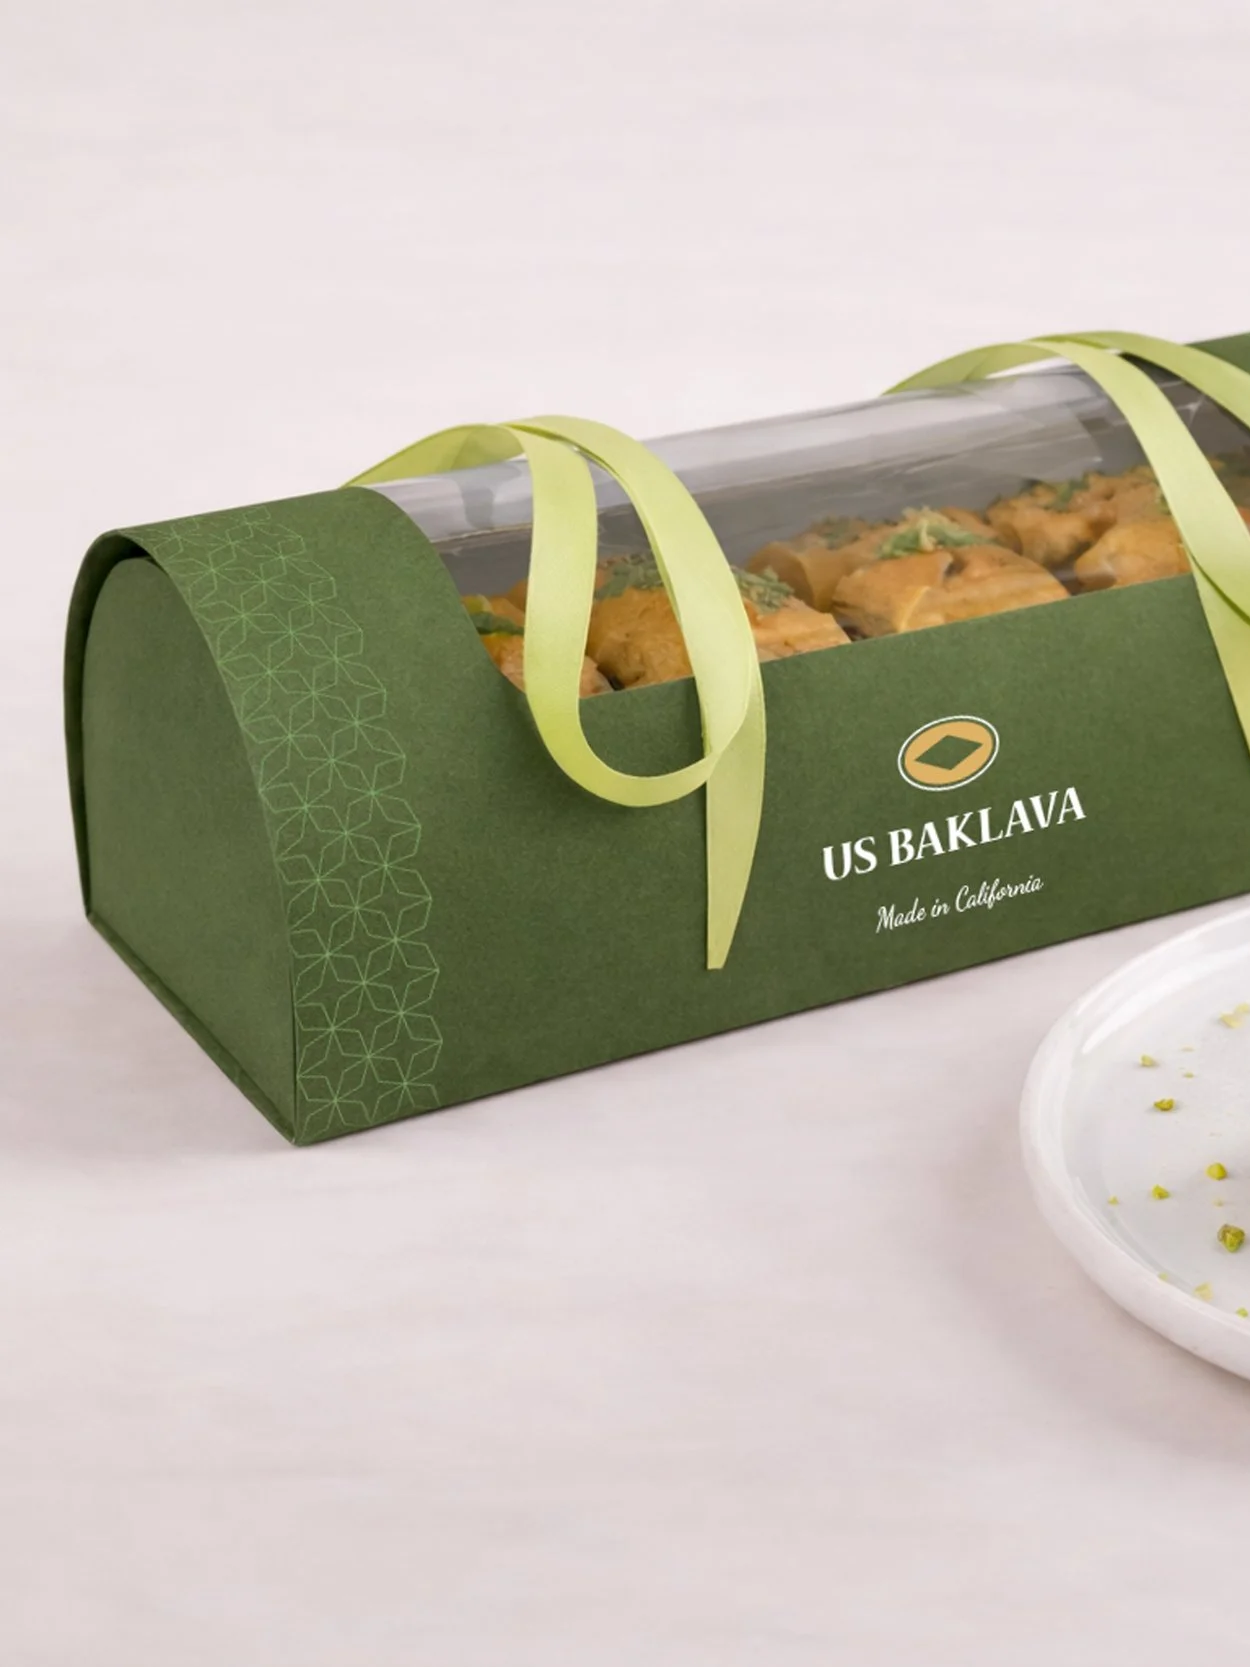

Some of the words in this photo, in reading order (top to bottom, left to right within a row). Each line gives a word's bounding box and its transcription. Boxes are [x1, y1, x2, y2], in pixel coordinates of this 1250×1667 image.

[822, 836, 878, 881] US
[888, 786, 1087, 866] BAKLAVA
[875, 896, 927, 933] Made
[930, 898, 950, 918] in
[955, 874, 1045, 913] California
